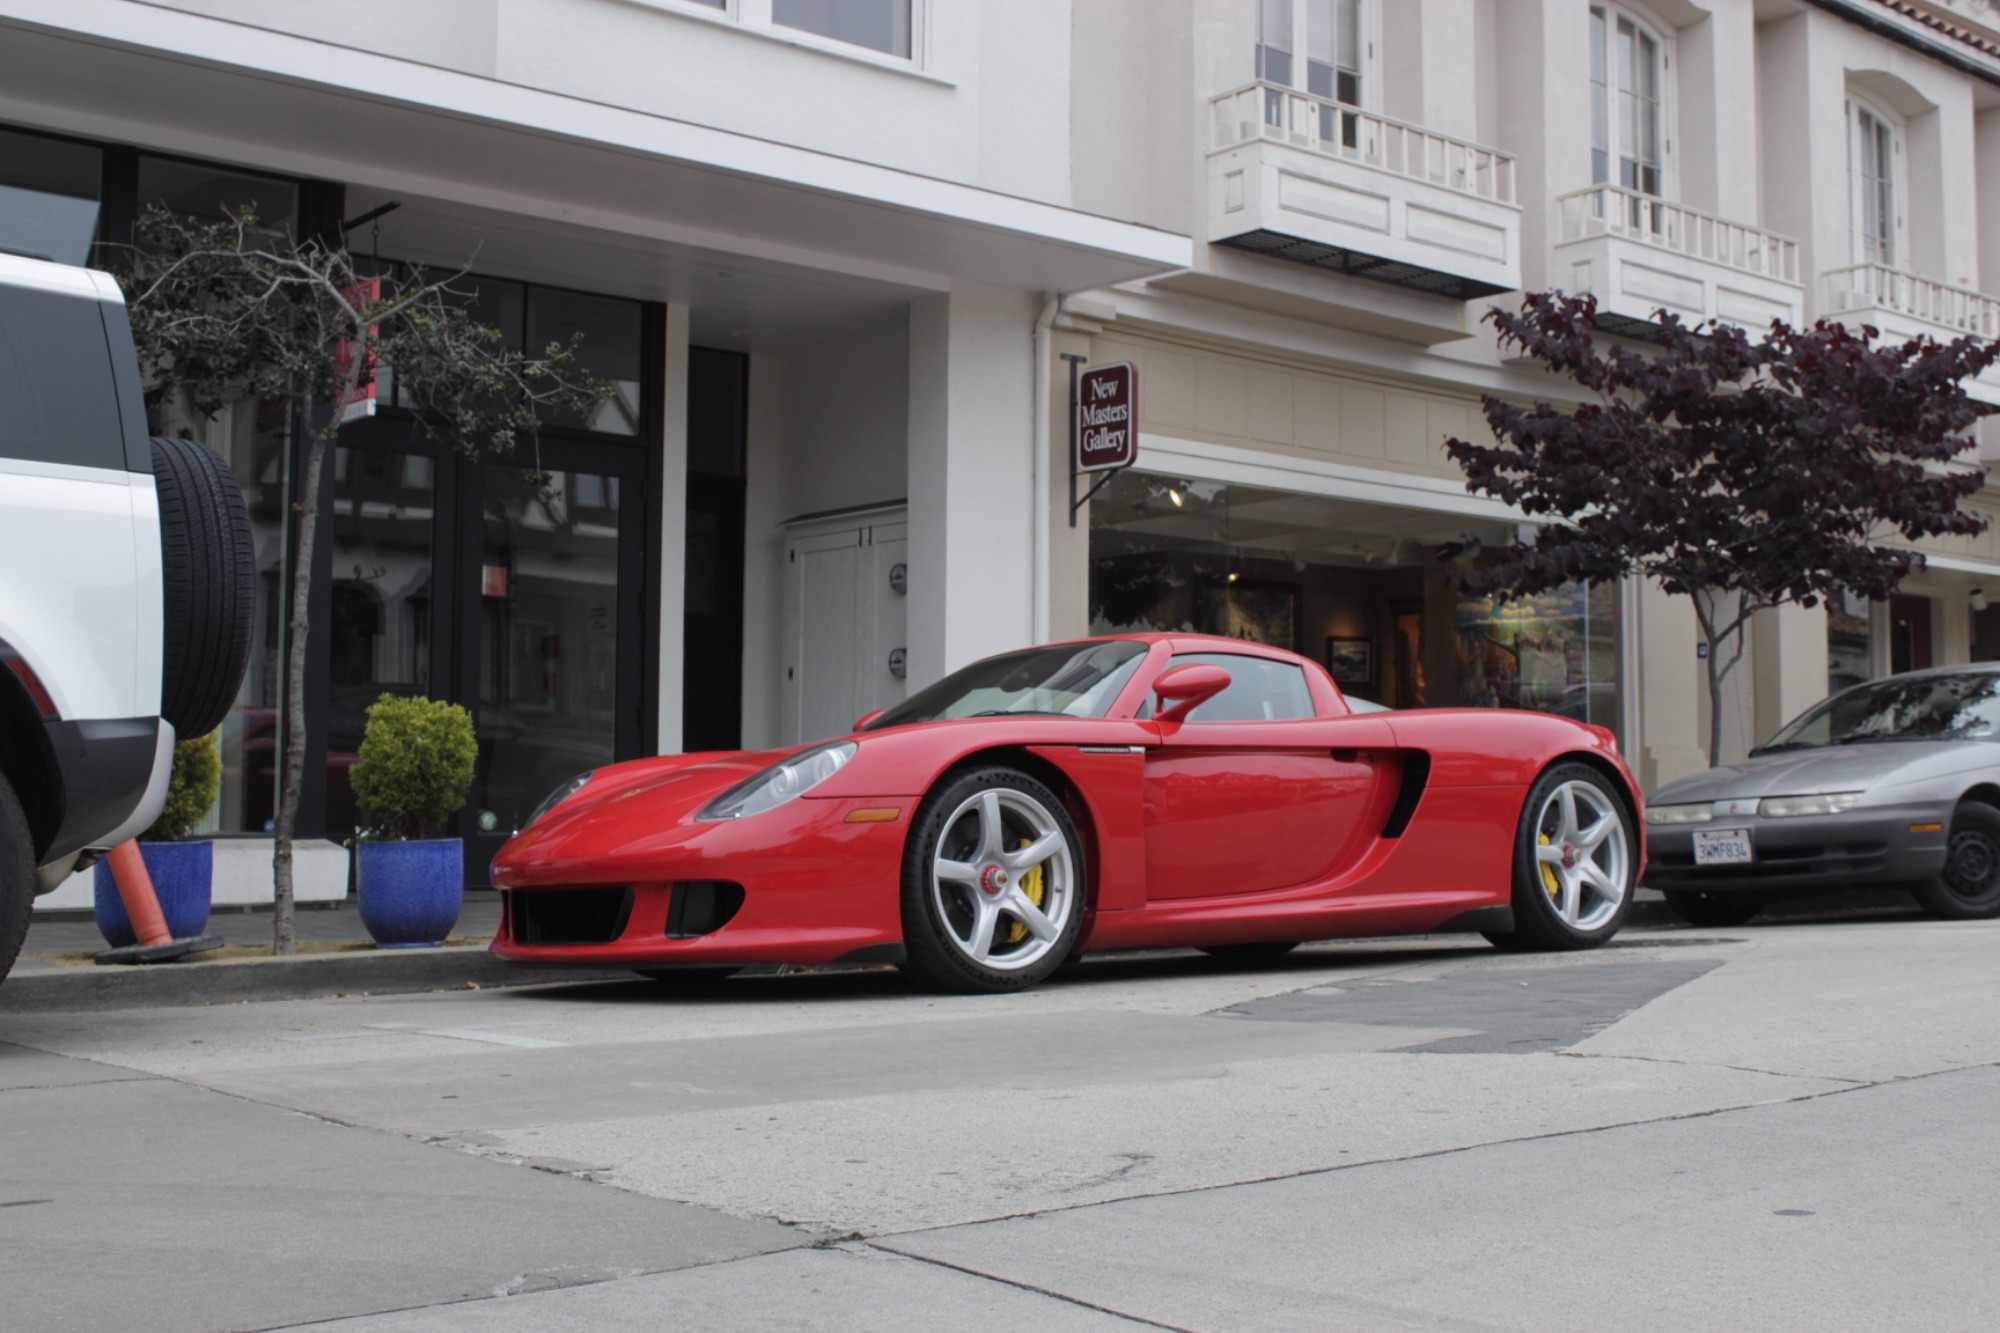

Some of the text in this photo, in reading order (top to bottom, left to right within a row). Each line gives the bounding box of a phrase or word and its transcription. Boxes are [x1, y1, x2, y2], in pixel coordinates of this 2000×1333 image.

[1091, 377, 1118, 401] New
[1082, 404, 1127, 427] Masters
[1083, 427, 1126, 452] Gallery
[1698, 842, 1747, 859] 3WMF834
